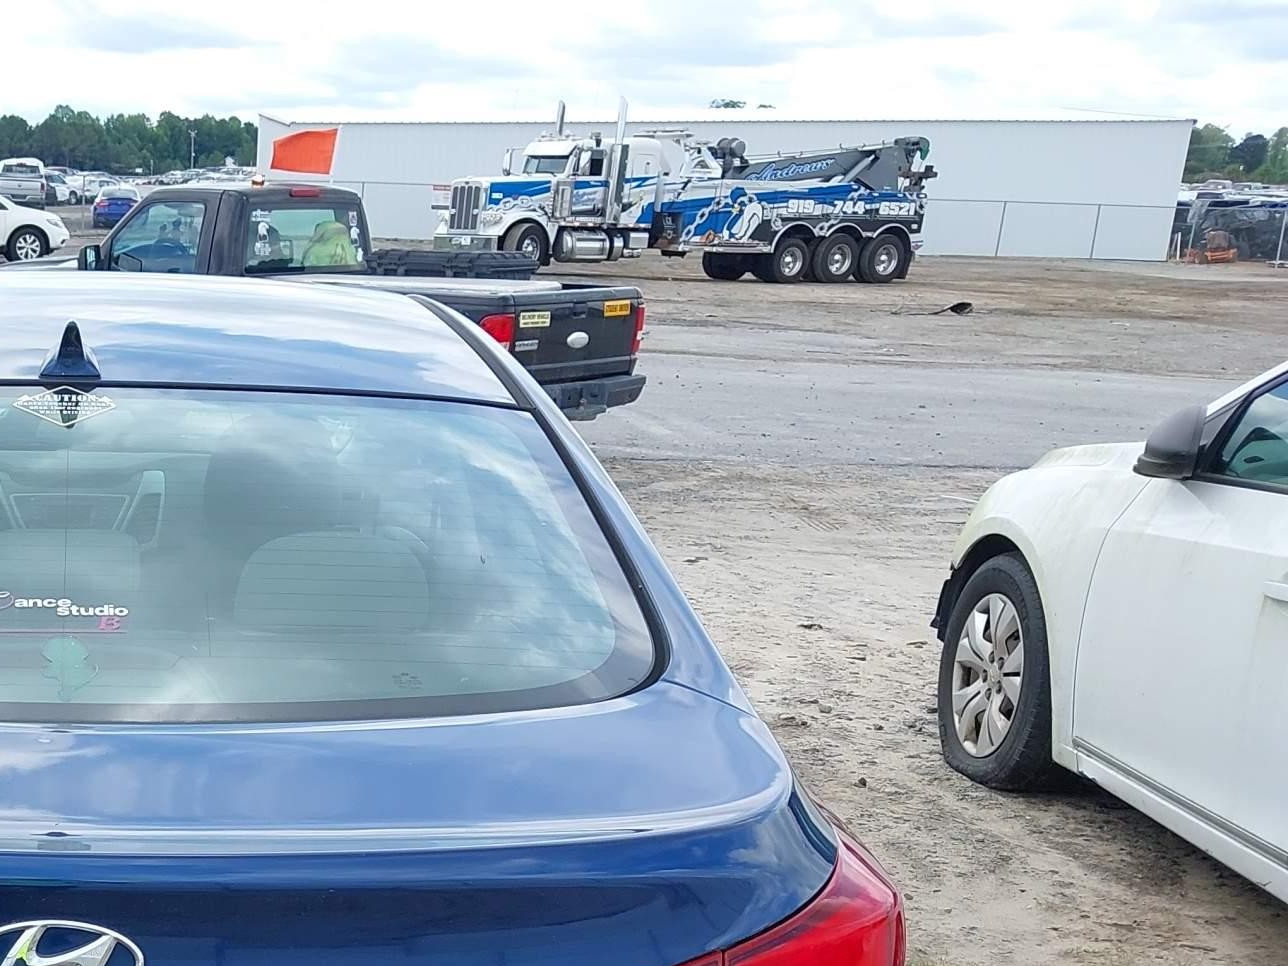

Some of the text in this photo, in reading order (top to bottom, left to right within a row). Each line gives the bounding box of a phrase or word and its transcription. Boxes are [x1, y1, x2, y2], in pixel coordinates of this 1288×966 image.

[788, 200, 915, 215] 919 744 6521
[57, 605, 129, 617] studio
